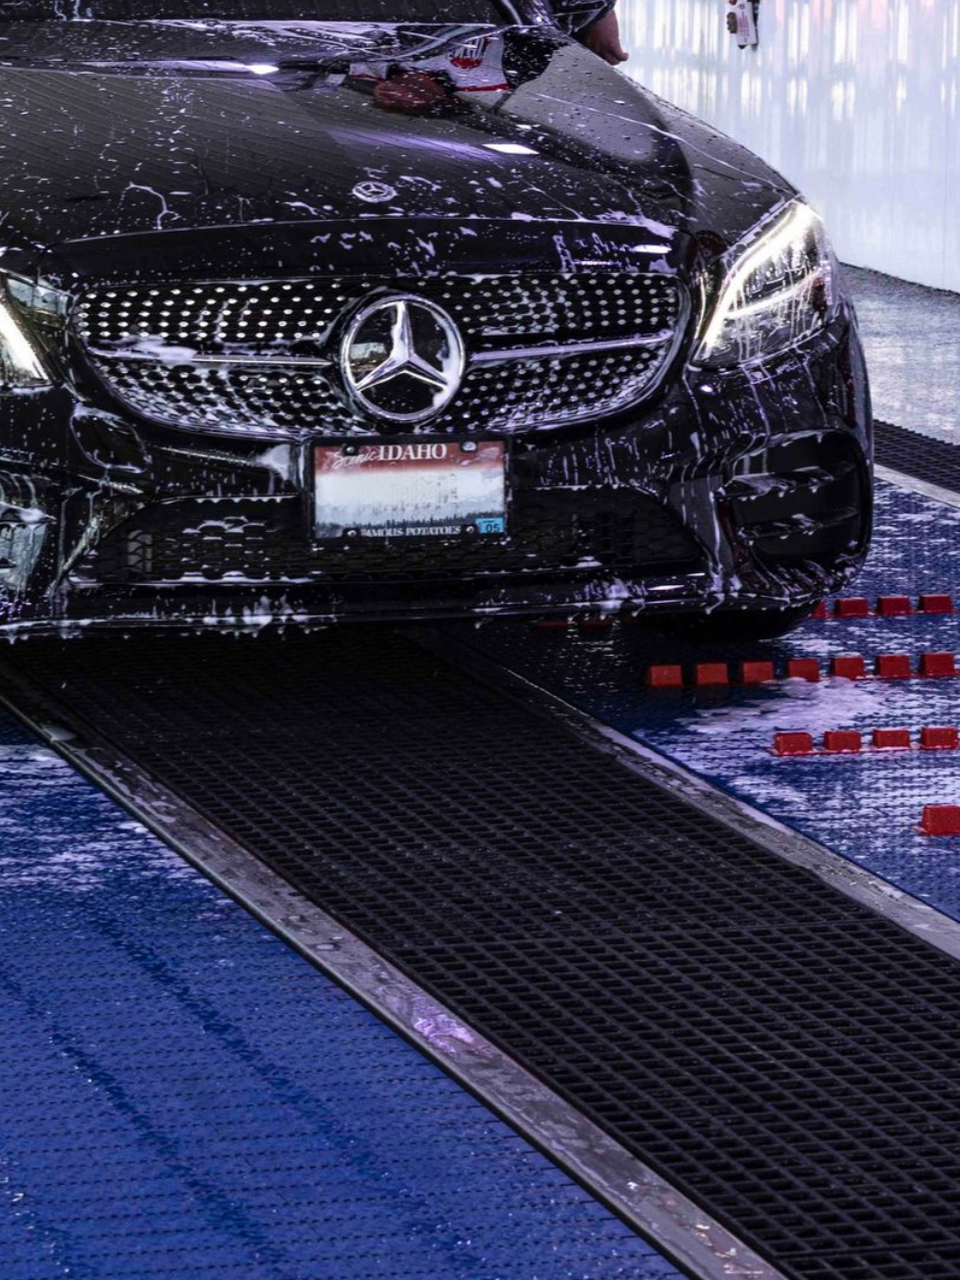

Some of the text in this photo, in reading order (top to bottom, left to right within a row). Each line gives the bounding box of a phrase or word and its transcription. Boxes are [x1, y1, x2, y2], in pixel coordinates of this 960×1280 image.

[379, 444, 447, 461] IDAHO
[361, 525, 461, 538] FAMOUS POTATOES
